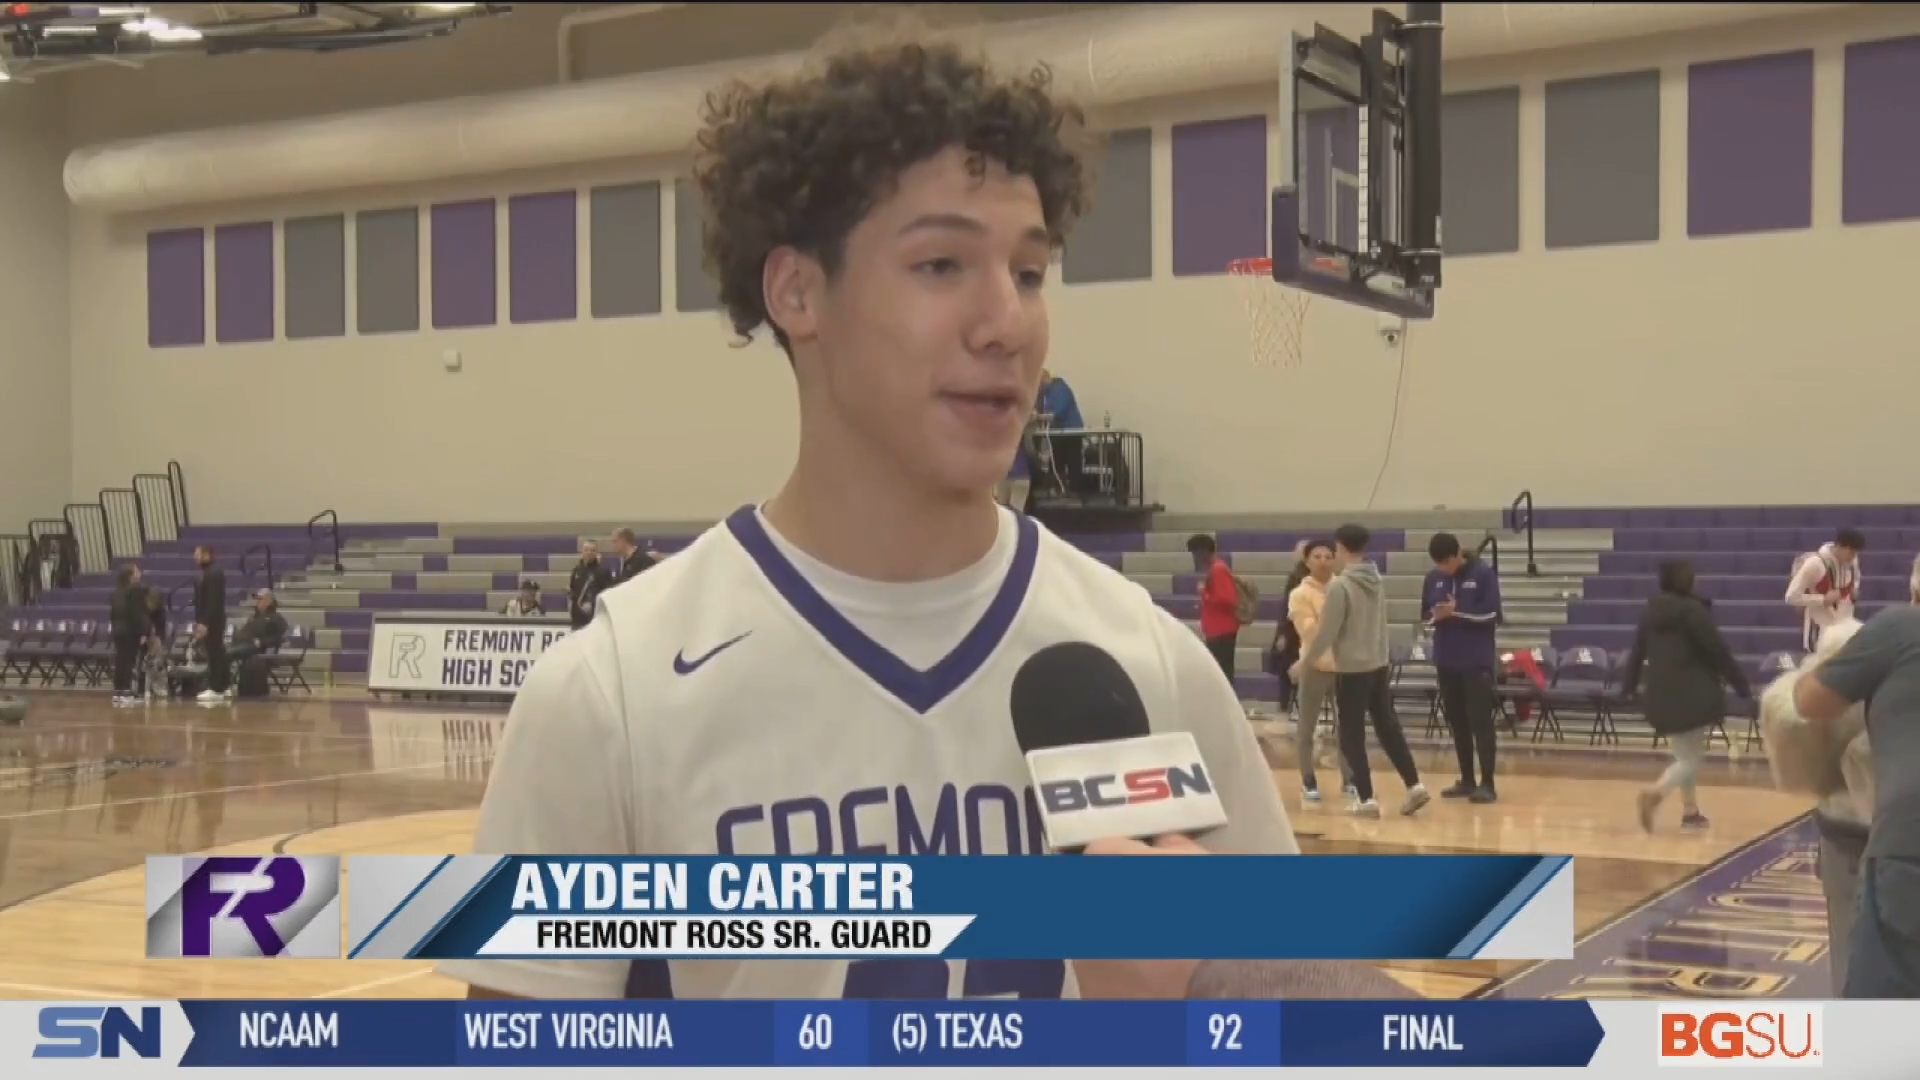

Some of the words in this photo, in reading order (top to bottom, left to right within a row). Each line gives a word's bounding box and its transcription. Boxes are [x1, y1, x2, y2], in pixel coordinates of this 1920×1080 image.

[443, 630, 535, 653] FREMONT
[441, 657, 492, 685] HIGH
[499, 659, 535, 686] SC
[1041, 763, 1211, 814] BCSN
